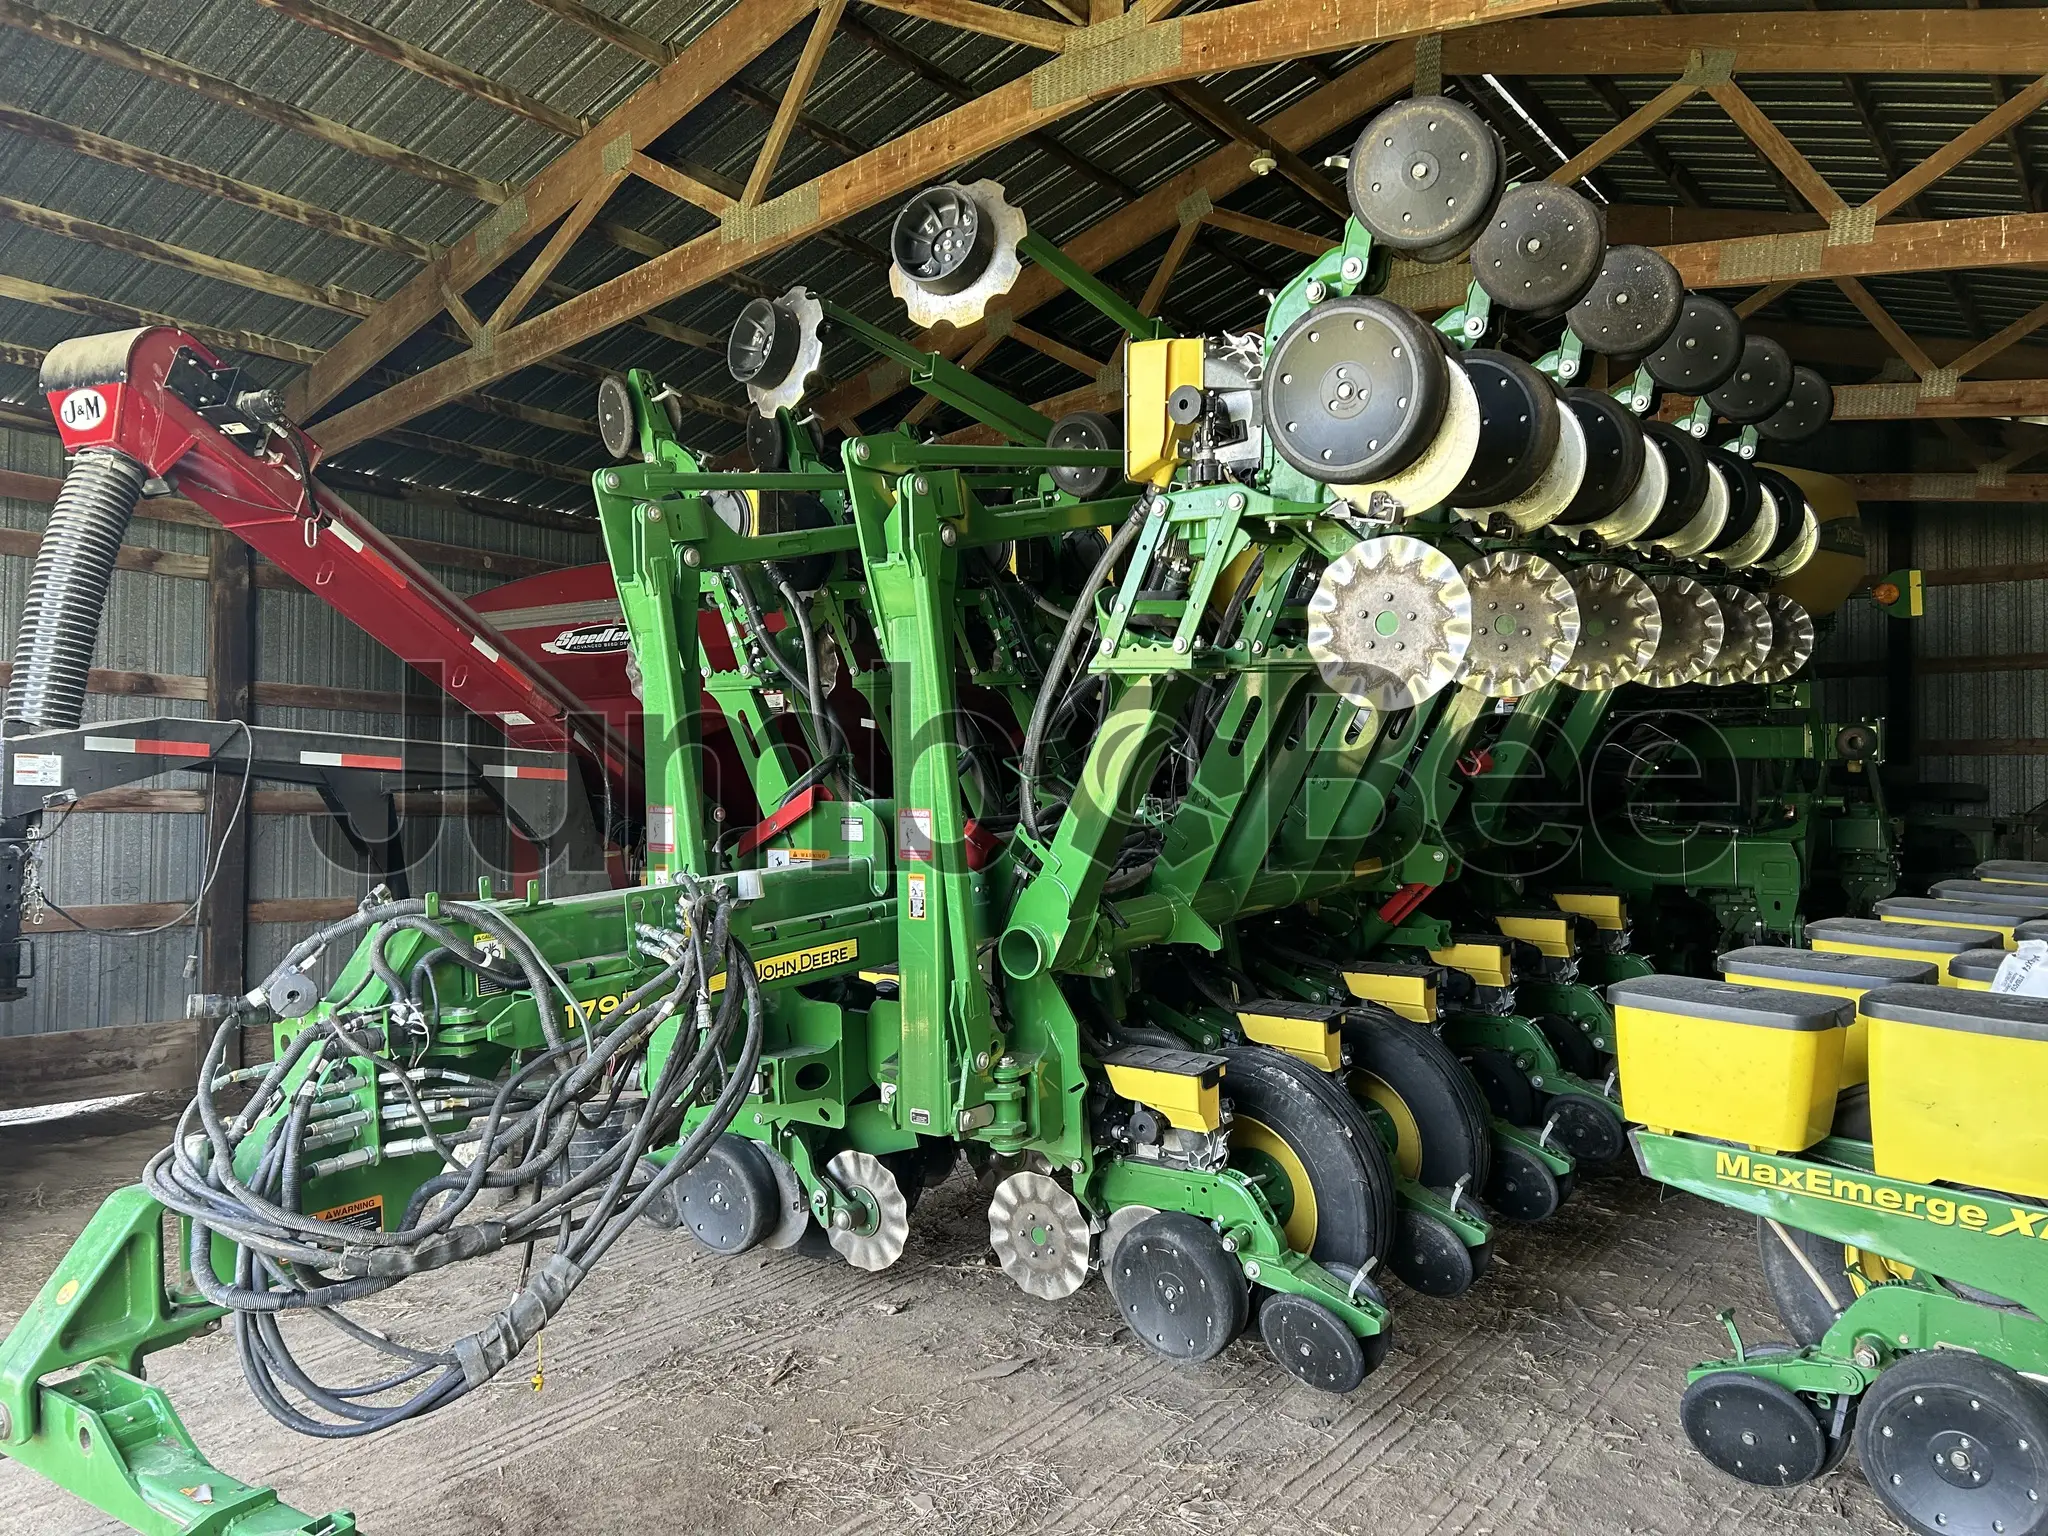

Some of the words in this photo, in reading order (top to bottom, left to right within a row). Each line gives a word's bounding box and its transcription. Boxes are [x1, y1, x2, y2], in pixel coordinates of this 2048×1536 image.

[64, 396, 100, 424] J&M
[757, 959, 797, 981] JOHN
[800, 946, 849, 972] DEERE
[1715, 1151, 1989, 1226] MaxEmerge
[332, 1199, 375, 1219] WARNING
